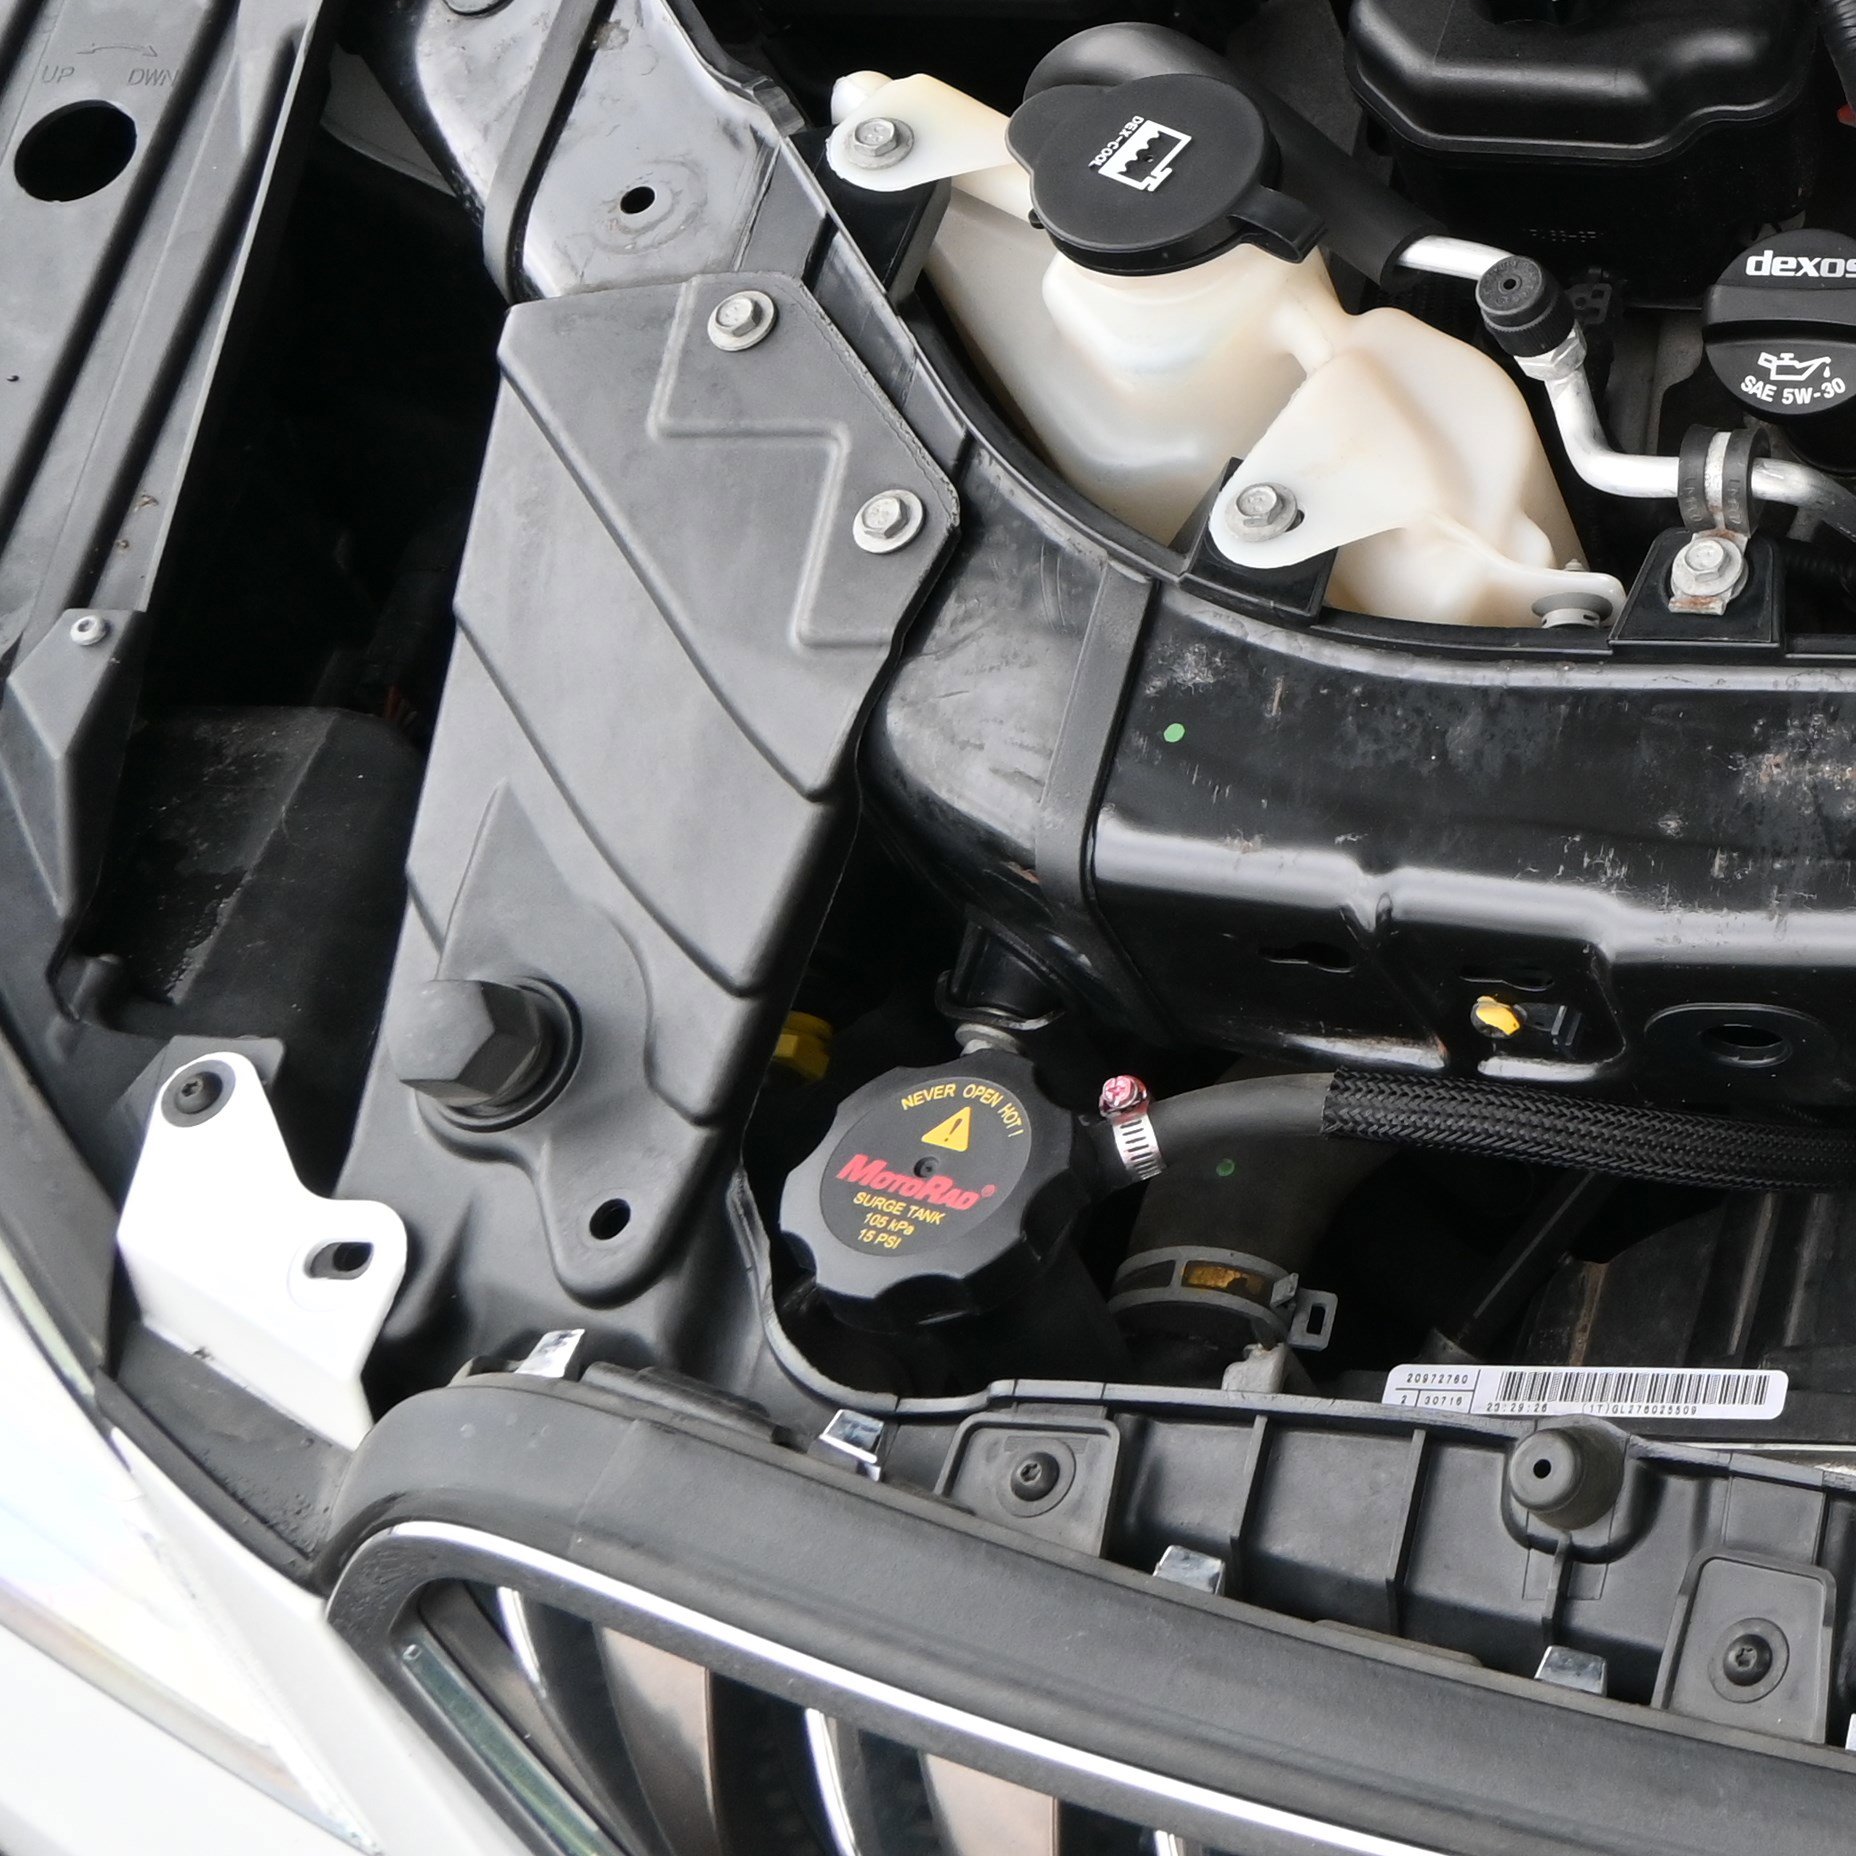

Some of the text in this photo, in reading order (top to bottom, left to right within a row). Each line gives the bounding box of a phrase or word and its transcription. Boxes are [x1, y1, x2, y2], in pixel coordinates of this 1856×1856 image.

[41, 65, 179, 87] UP DWN
[1087, 115, 1145, 169] DEX-COOL
[1740, 375, 1846, 405] SAE 5W-30
[901, 1083, 956, 1111] NEVER
[962, 1083, 1002, 1109] OPEN
[853, 1191, 946, 1226] SURGE TANK
[863, 1212, 916, 1237] 105 kPa
[857, 1228, 902, 1250] 15 PSI
[1406, 1373, 1469, 1385] 20972760
